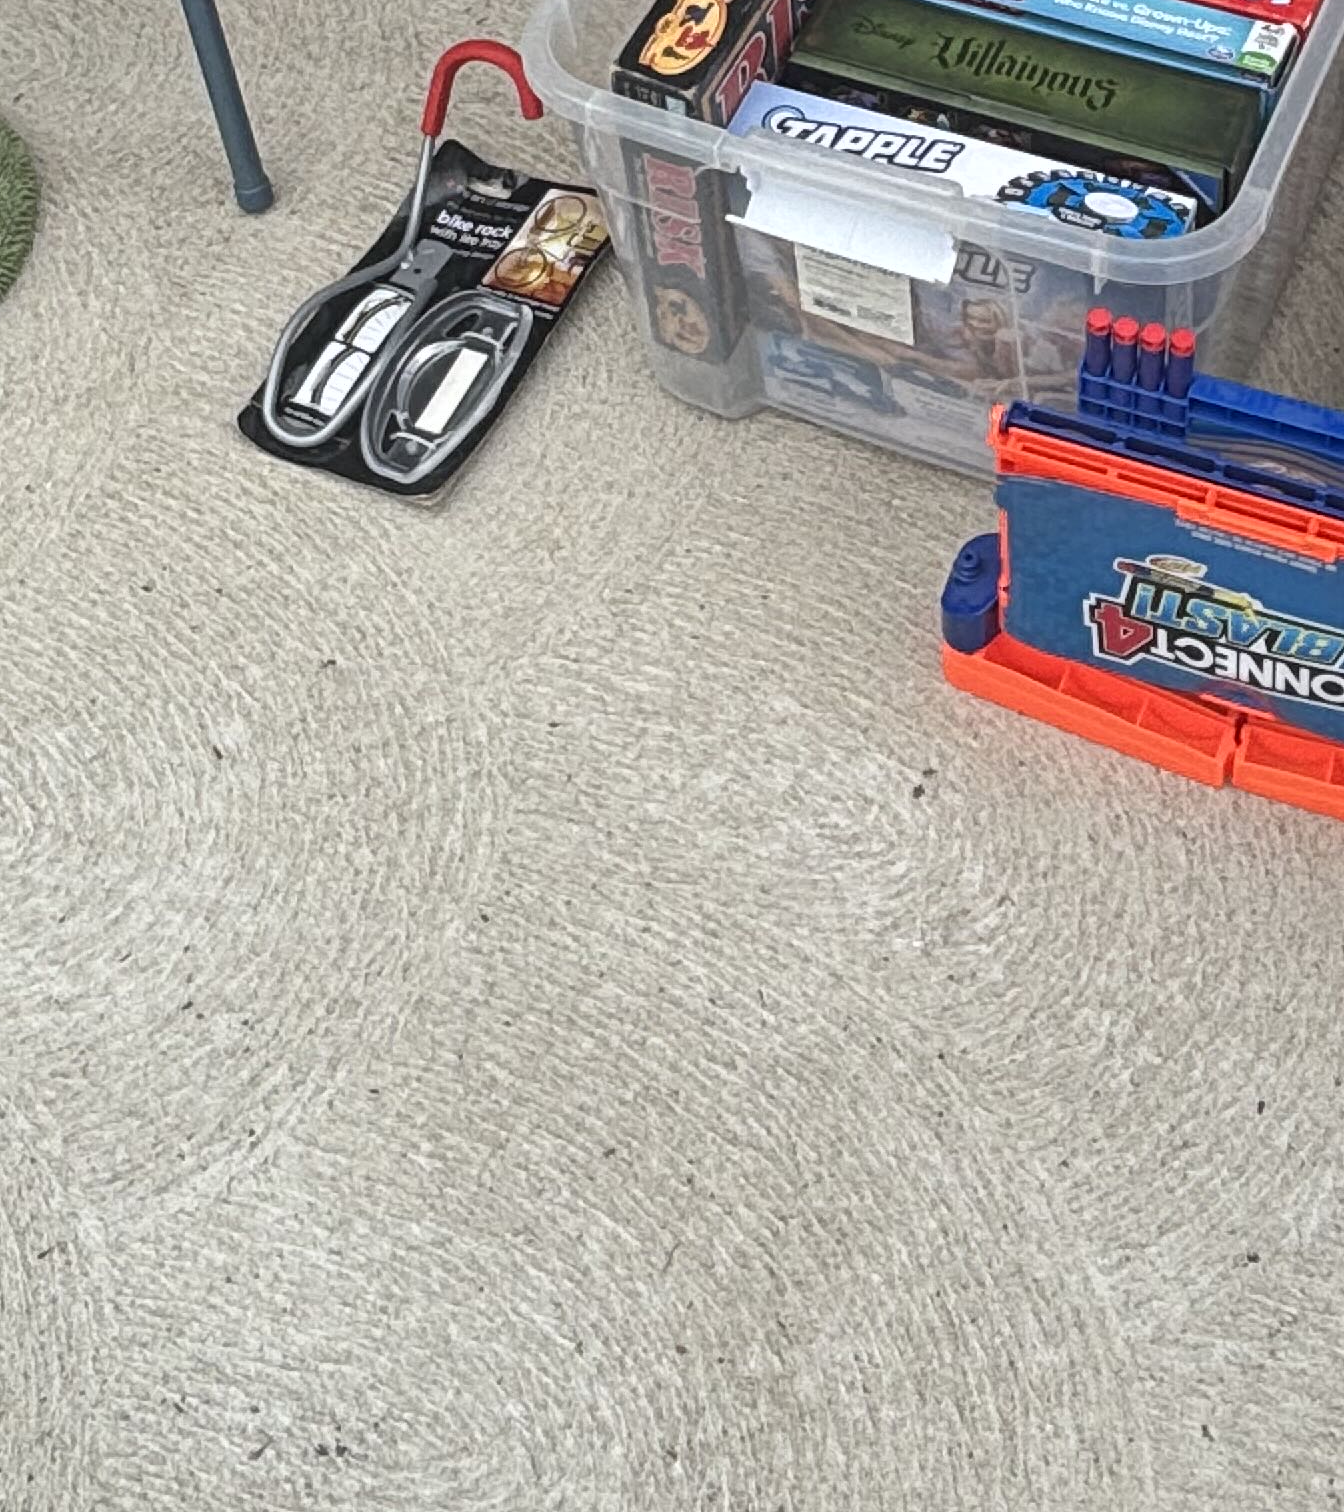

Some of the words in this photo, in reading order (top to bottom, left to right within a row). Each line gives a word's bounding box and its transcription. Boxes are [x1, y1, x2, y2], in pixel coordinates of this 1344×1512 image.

[855, 15, 917, 50] Disney
[932, 31, 1120, 110] Villainous
[763, 105, 966, 174] TAPPLE
[436, 209, 474, 232] bike
[474, 223, 514, 239] rack
[642, 153, 706, 280] RISK
[1094, 601, 1153, 656] 4
